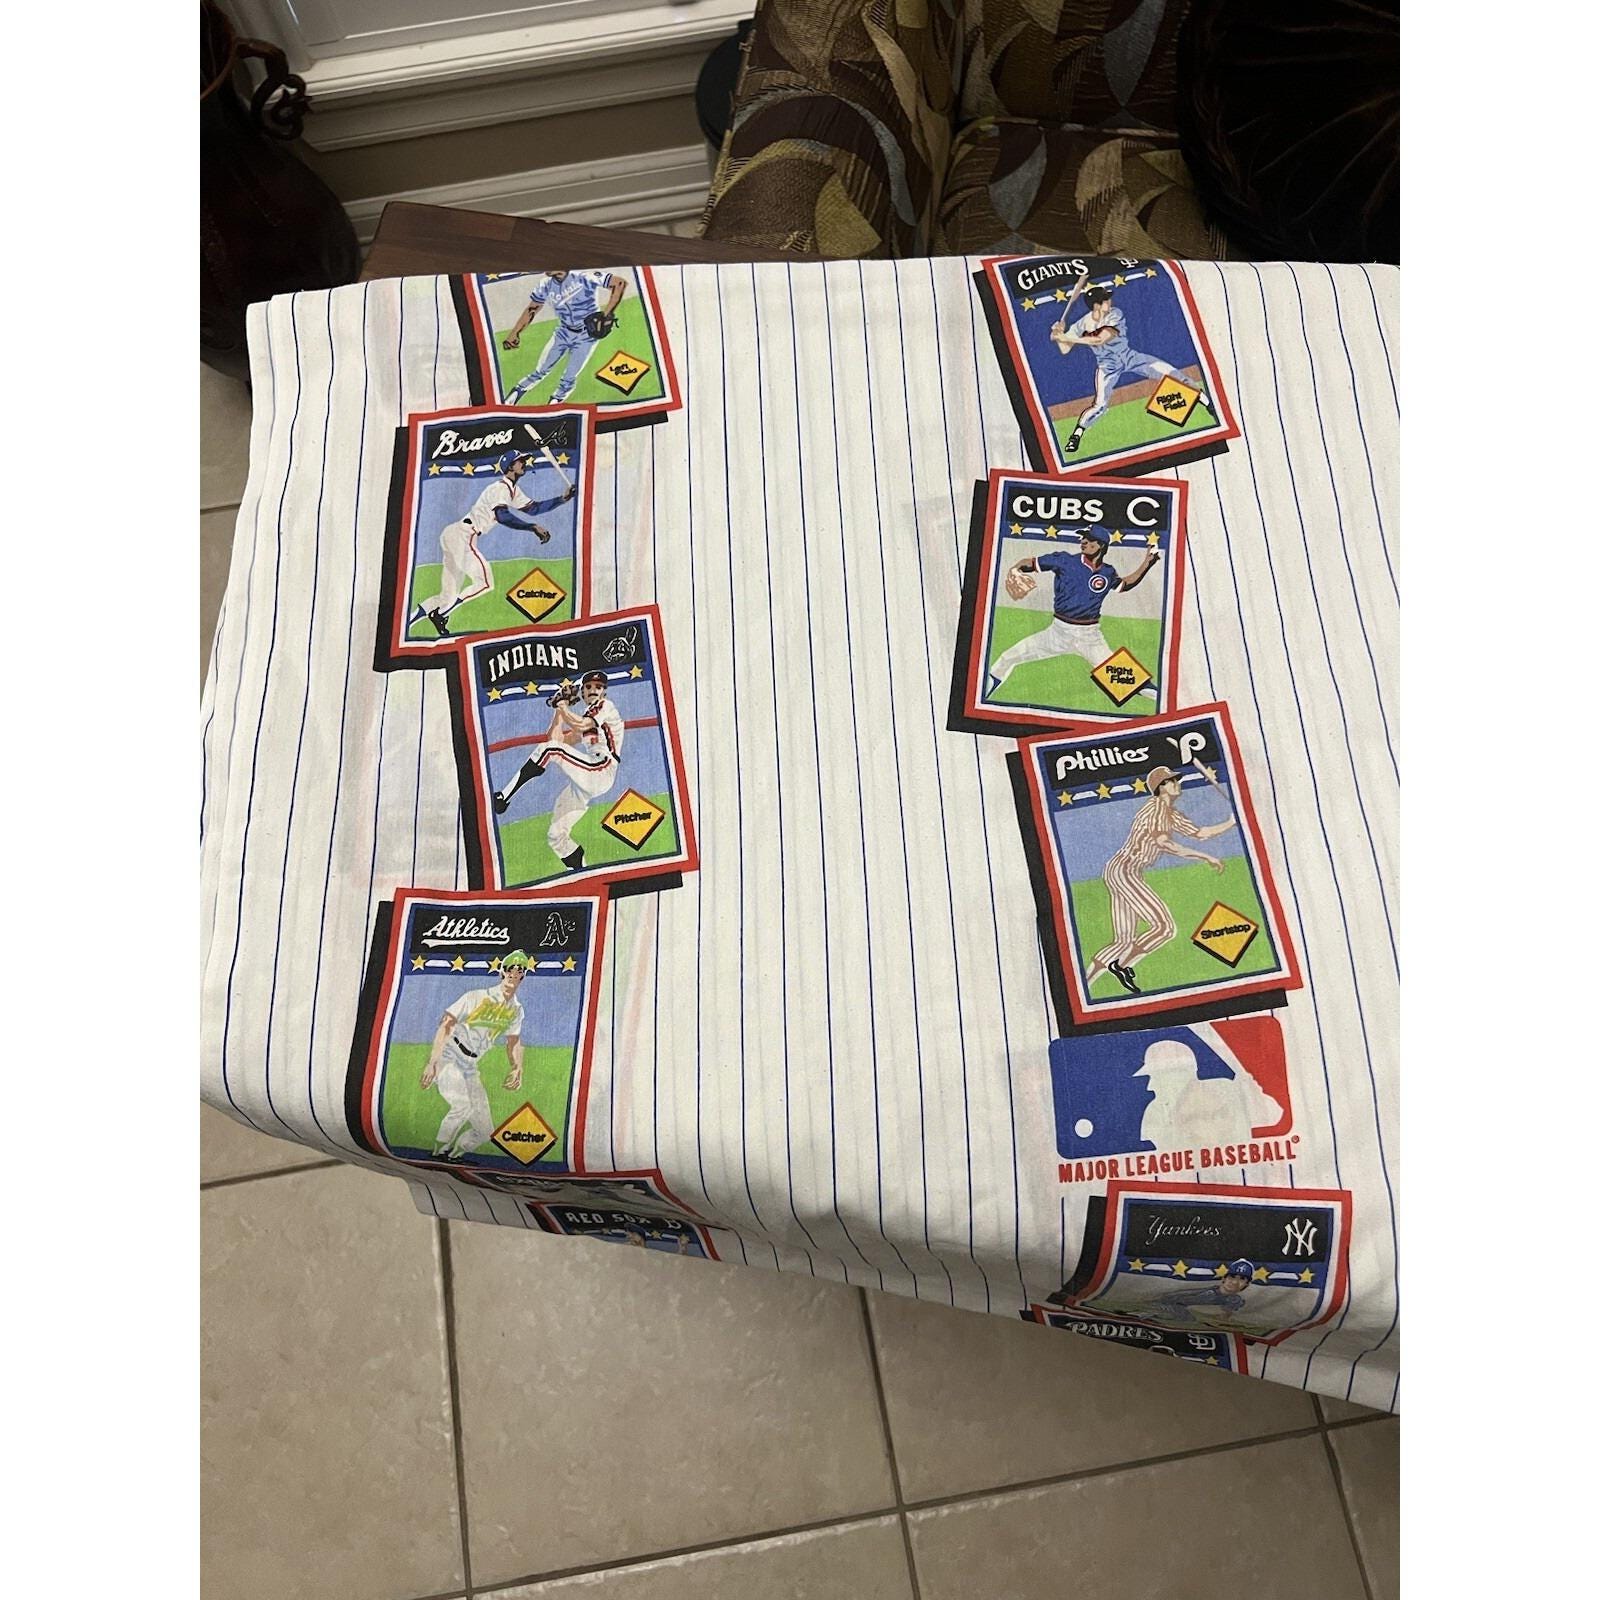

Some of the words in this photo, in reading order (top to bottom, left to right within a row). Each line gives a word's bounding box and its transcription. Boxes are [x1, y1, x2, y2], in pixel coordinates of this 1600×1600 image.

[1017, 259, 1089, 290] GIANTS
[1156, 392, 1182, 405] Right
[1163, 399, 1187, 412] Field
[431, 428, 514, 460] Braves
[1012, 495, 1104, 523] CUBS
[1126, 496, 1160, 526] C
[516, 588, 558, 600] Catcher
[488, 643, 579, 682] INDIANS
[1105, 665, 1133, 677] Right
[1110, 674, 1135, 685] Field
[1055, 746, 1149, 780] Phillies
[613, 810, 652, 825] Pitcher
[421, 915, 510, 948] Athletics
[1200, 922, 1251, 941] Shortstop
[501, 1130, 547, 1143] Catcher
[1058, 1158, 1120, 1183] MAJOR
[1125, 1149, 1194, 1177] LEAGUE
[565, 1211, 604, 1224] RED
[611, 1212, 651, 1225] SOX
[1145, 1214, 1222, 1246] Yankees
[1281, 1217, 1318, 1256] NY
[1064, 1321, 1164, 1343] PADRES
